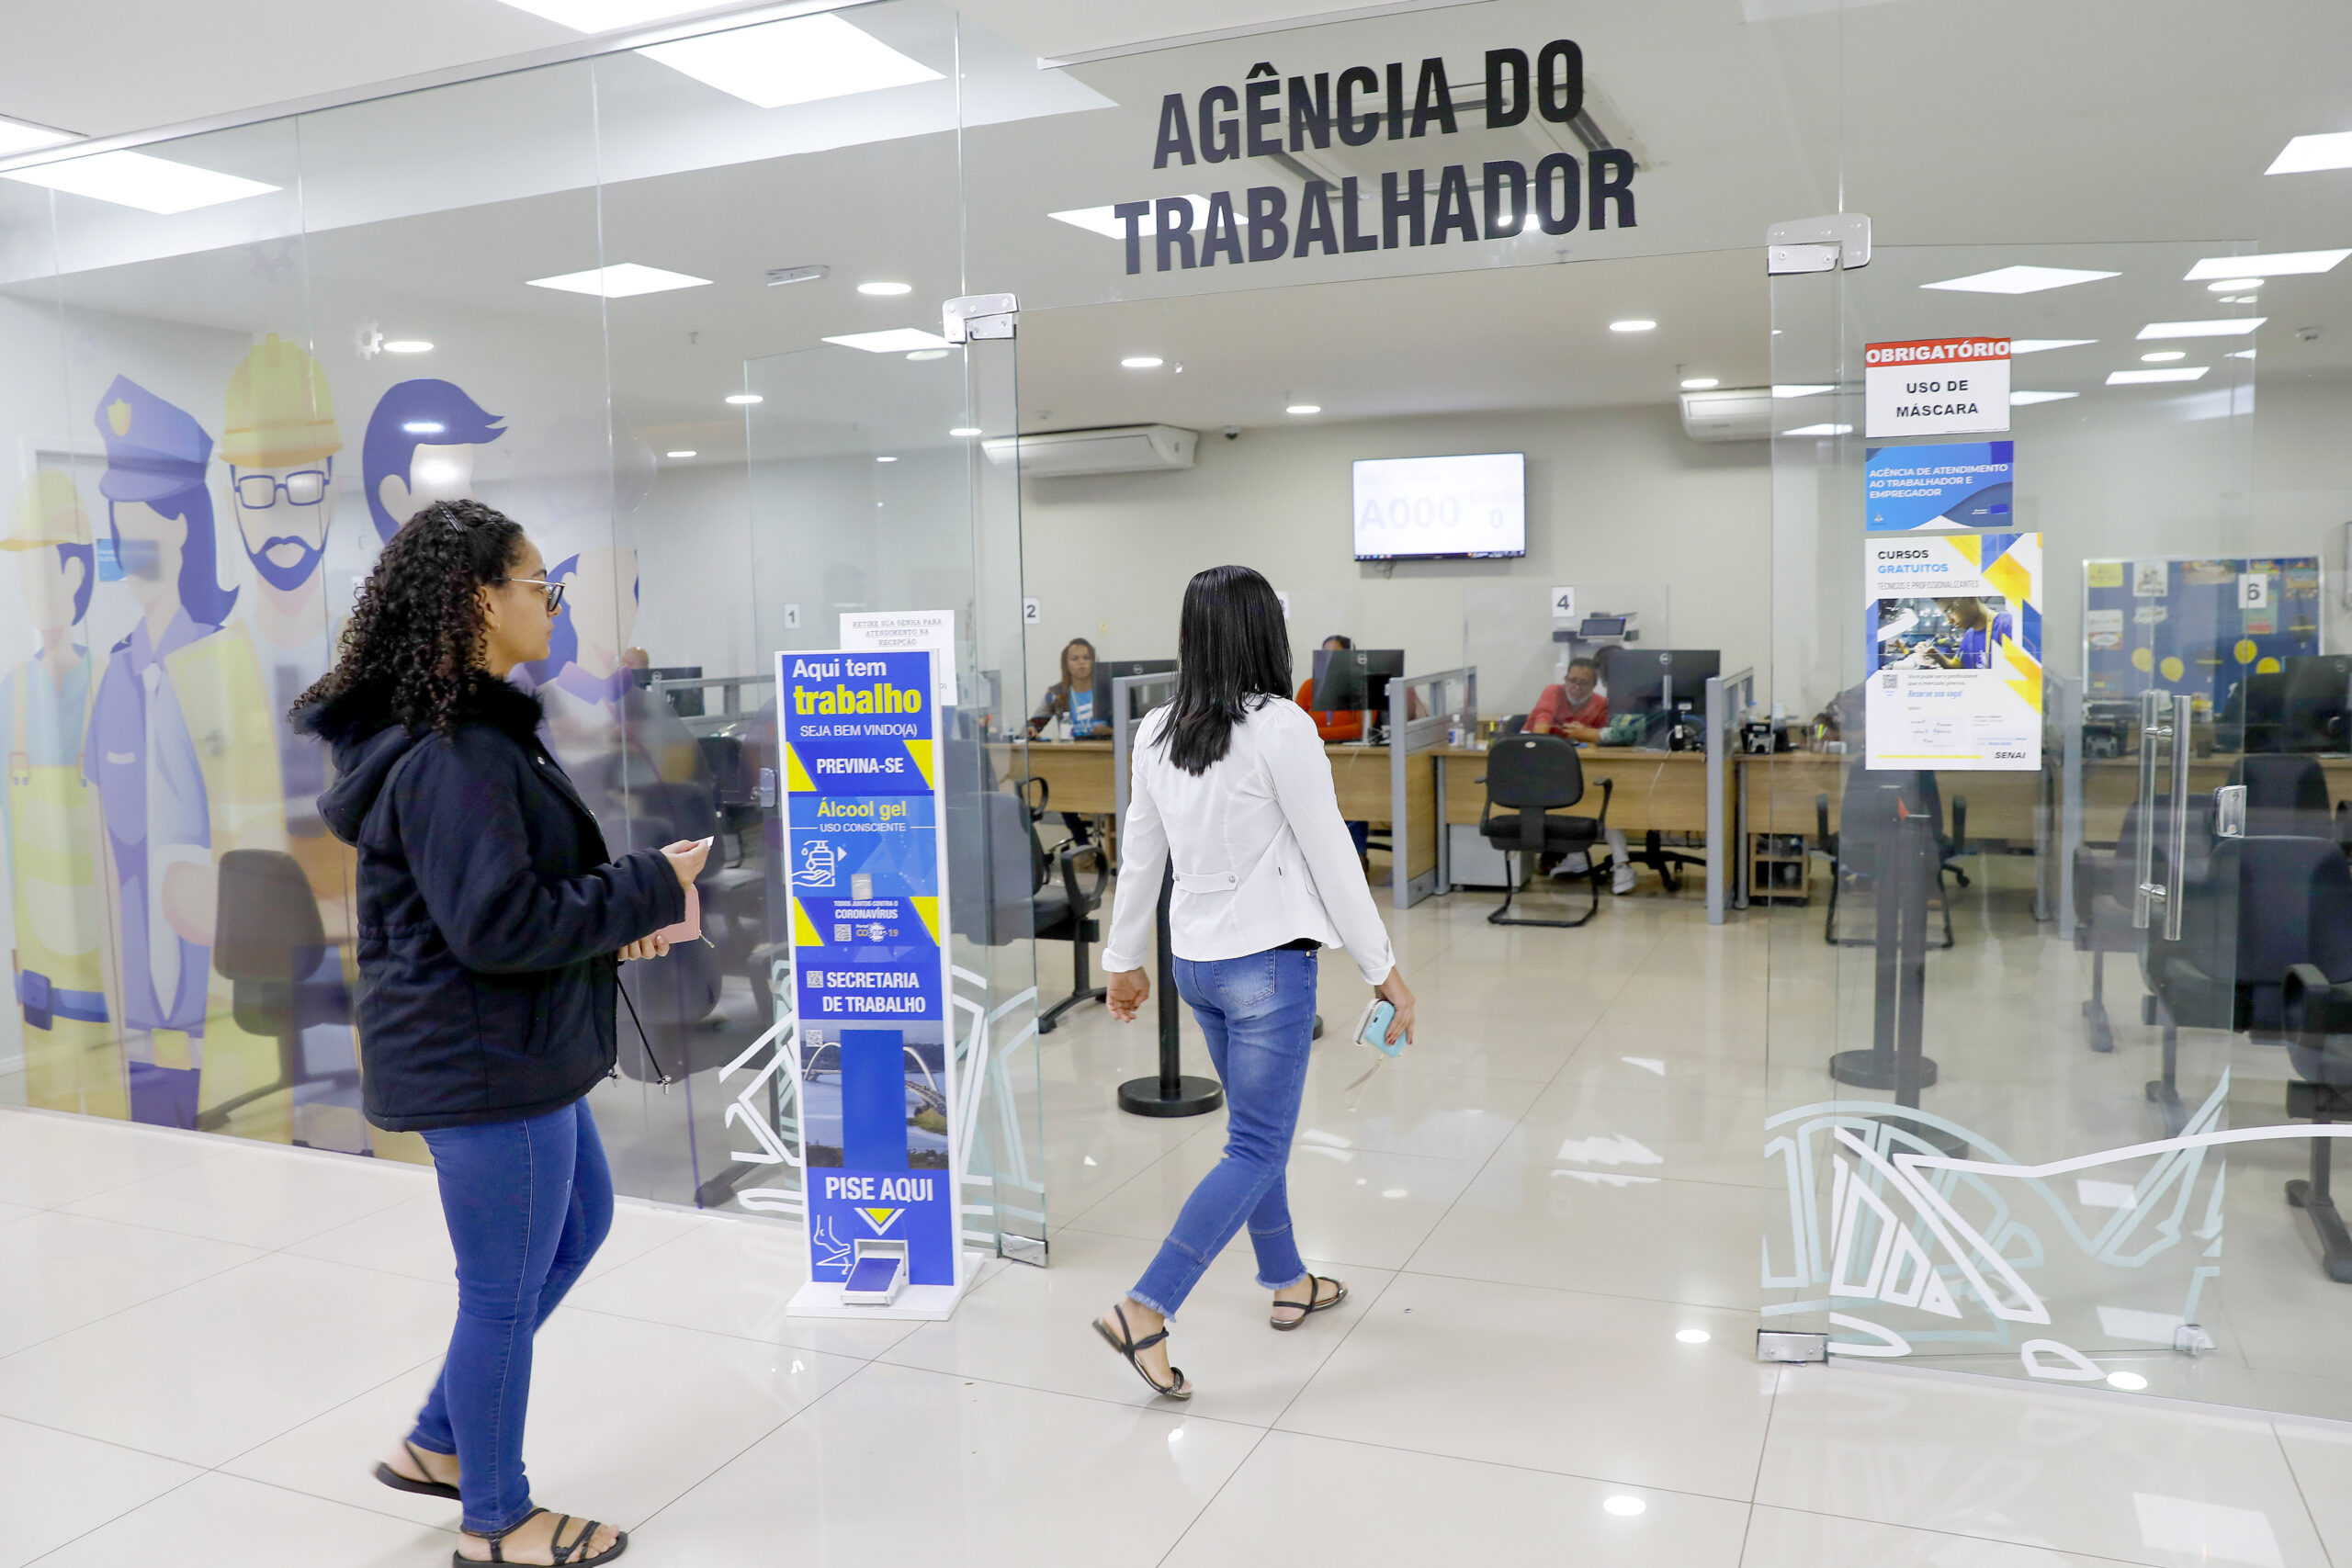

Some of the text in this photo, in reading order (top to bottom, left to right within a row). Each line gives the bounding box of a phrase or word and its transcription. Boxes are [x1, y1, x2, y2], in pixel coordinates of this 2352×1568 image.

[1152, 39, 1583, 170] AGÊNCIA DO
[1114, 148, 1637, 276] TRABALHADOR
[1866, 341, 2010, 363] OBRIGATÓRIO
[1906, 379, 1969, 394] USO DE
[1896, 402, 1979, 418] MÁSCARA
[1869, 463, 2008, 478] AGÊNCIA DE ATENDIMENTO
[1869, 476, 1973, 489] AO TRABALHADOR E
[1869, 488, 1942, 499] EMPREGADOR
[1359, 496, 1460, 530] A000
[1878, 549, 1929, 559] CURSOS
[1878, 563, 1949, 574] GRATUITOS
[2247, 583, 2260, 601] 6
[1556, 594, 1570, 610] 4
[788, 611, 796, 624] 1
[1025, 605, 1036, 617] 2
[865, 628, 918, 637] ATENDIMENTO
[792, 659, 888, 682] Aqui tem
[793, 683, 922, 716] trabalho
[800, 723, 918, 738] SEJA BEM VINDO(A)
[1995, 751, 2026, 760] SENAI
[816, 757, 905, 774] PREVINA-SE
[817, 797, 907, 821] Álcool gel
[820, 823, 907, 832] USO CONSCIENTE
[834, 908, 899, 919] CORONAVÍRUS
[827, 972, 920, 988] SECRETARIA
[822, 996, 926, 1013] DE TRABALHO
[826, 1177, 933, 1202] PISE AQUI
